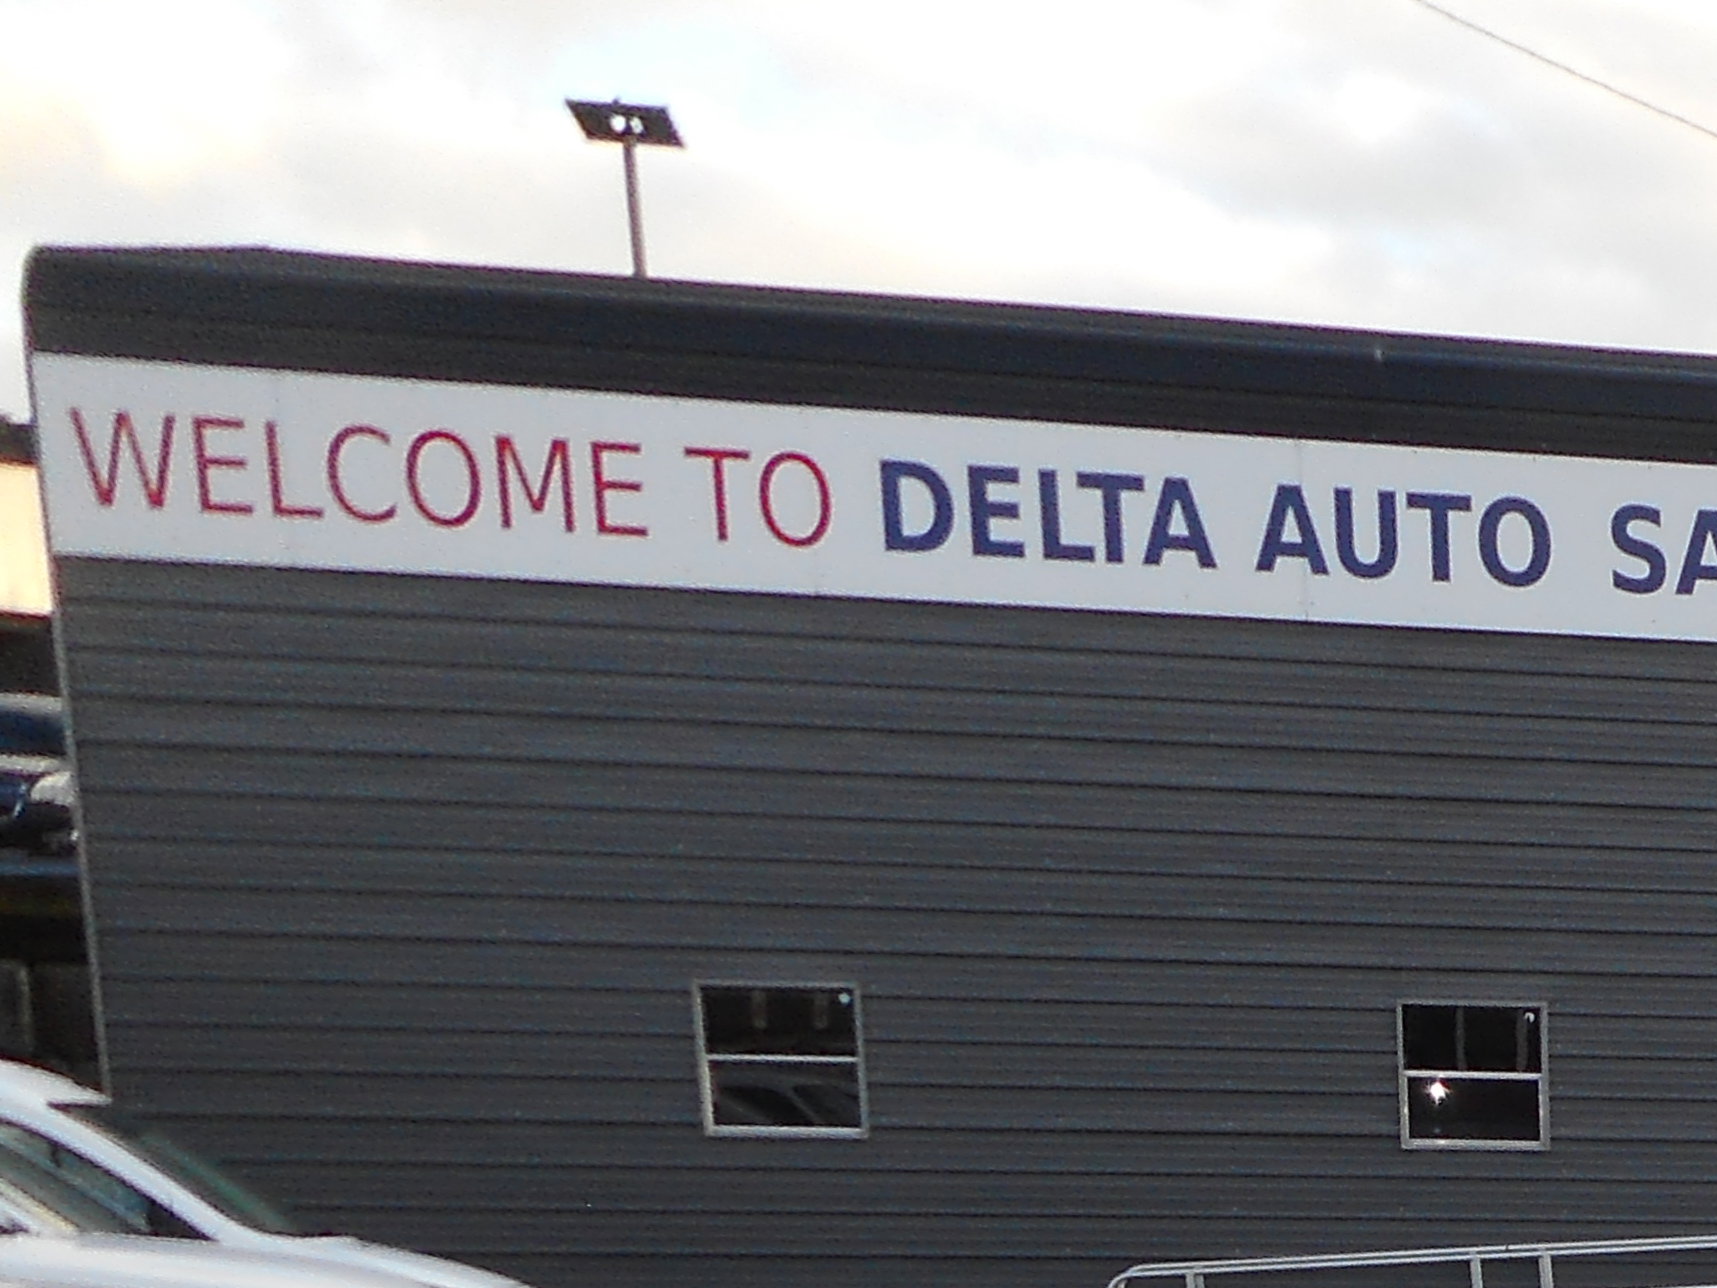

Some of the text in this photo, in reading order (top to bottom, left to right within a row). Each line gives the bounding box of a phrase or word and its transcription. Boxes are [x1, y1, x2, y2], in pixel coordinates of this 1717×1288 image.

[72, 406, 648, 536] WELCOME
[684, 446, 833, 548] TO
[879, 457, 1217, 571] DELTA
[1255, 483, 1553, 588] AUTO
